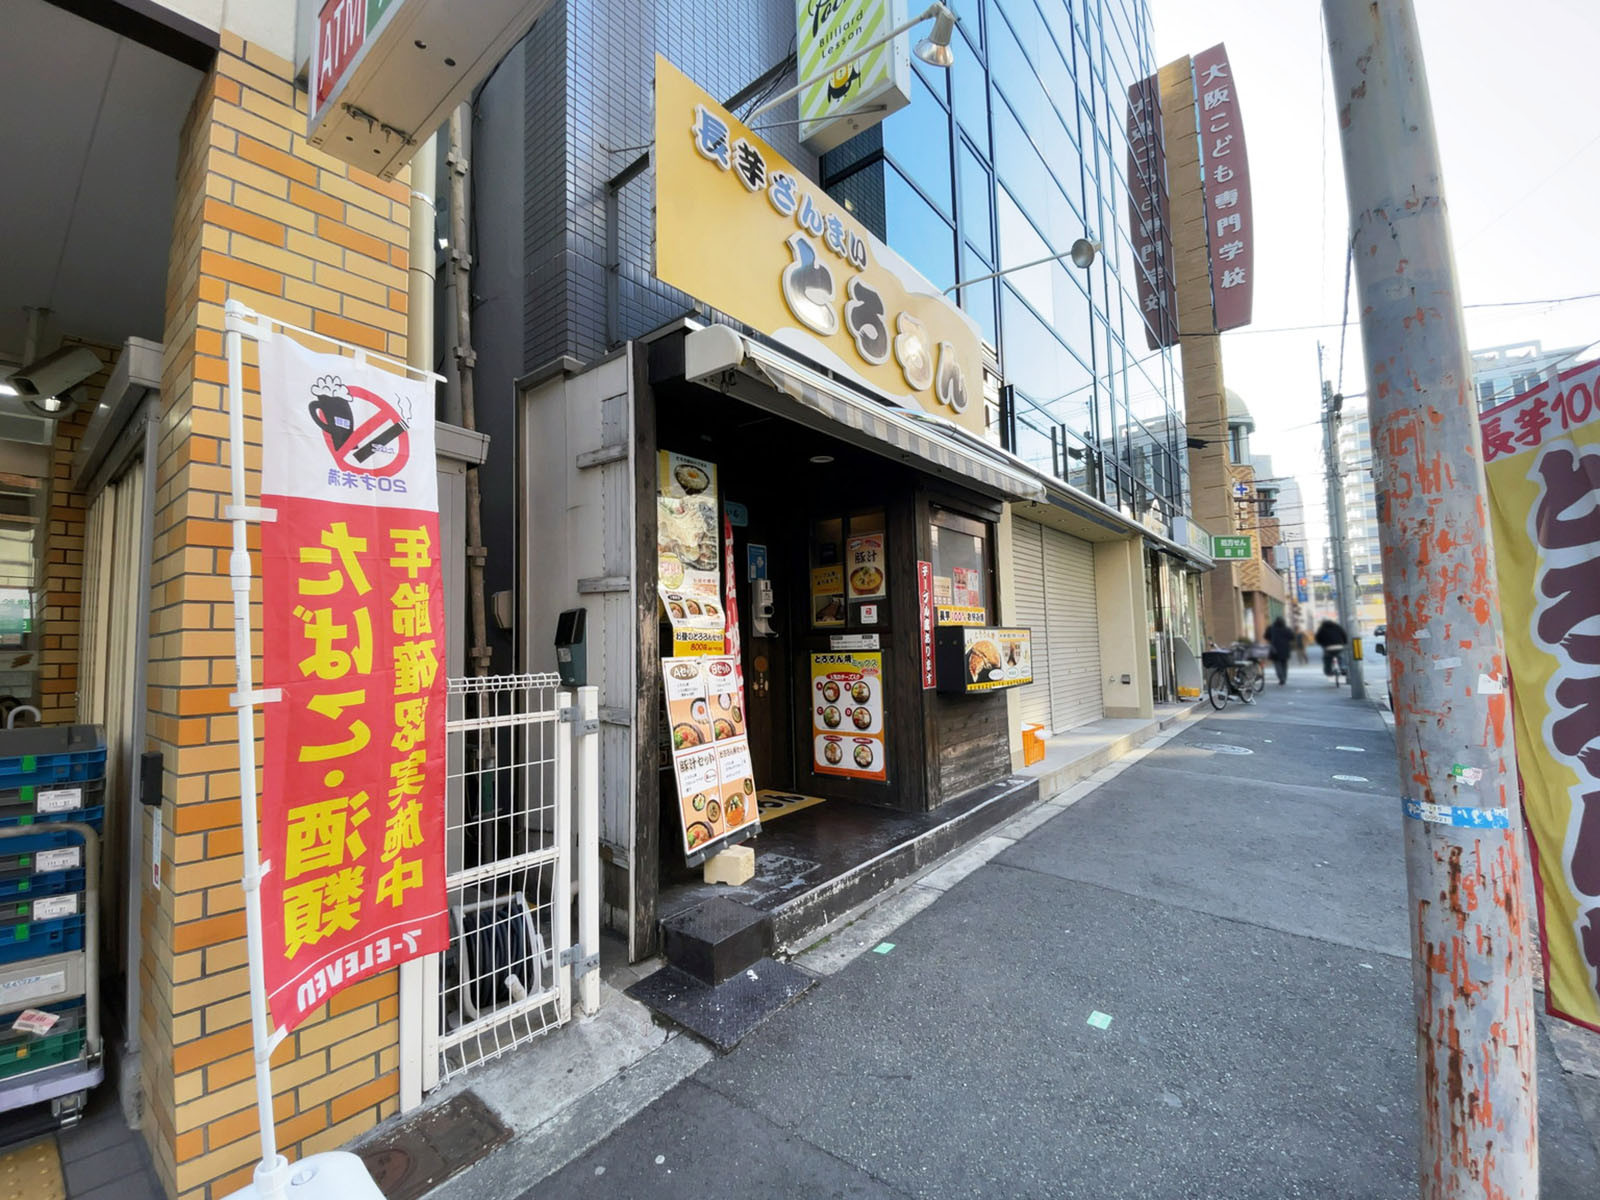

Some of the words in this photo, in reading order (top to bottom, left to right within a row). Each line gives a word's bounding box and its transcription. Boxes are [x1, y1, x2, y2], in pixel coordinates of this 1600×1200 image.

[319, 0, 361, 91] ATM
[822, 26, 862, 59] Lesson
[692, 104, 867, 271] 長芋ざんまい
[1201, 62, 1247, 289] 大阪こども専門学校
[782, 231, 969, 415] とろろん
[1481, 375, 1600, 462] 長芋10
[855, 550, 877, 564] 豚汁
